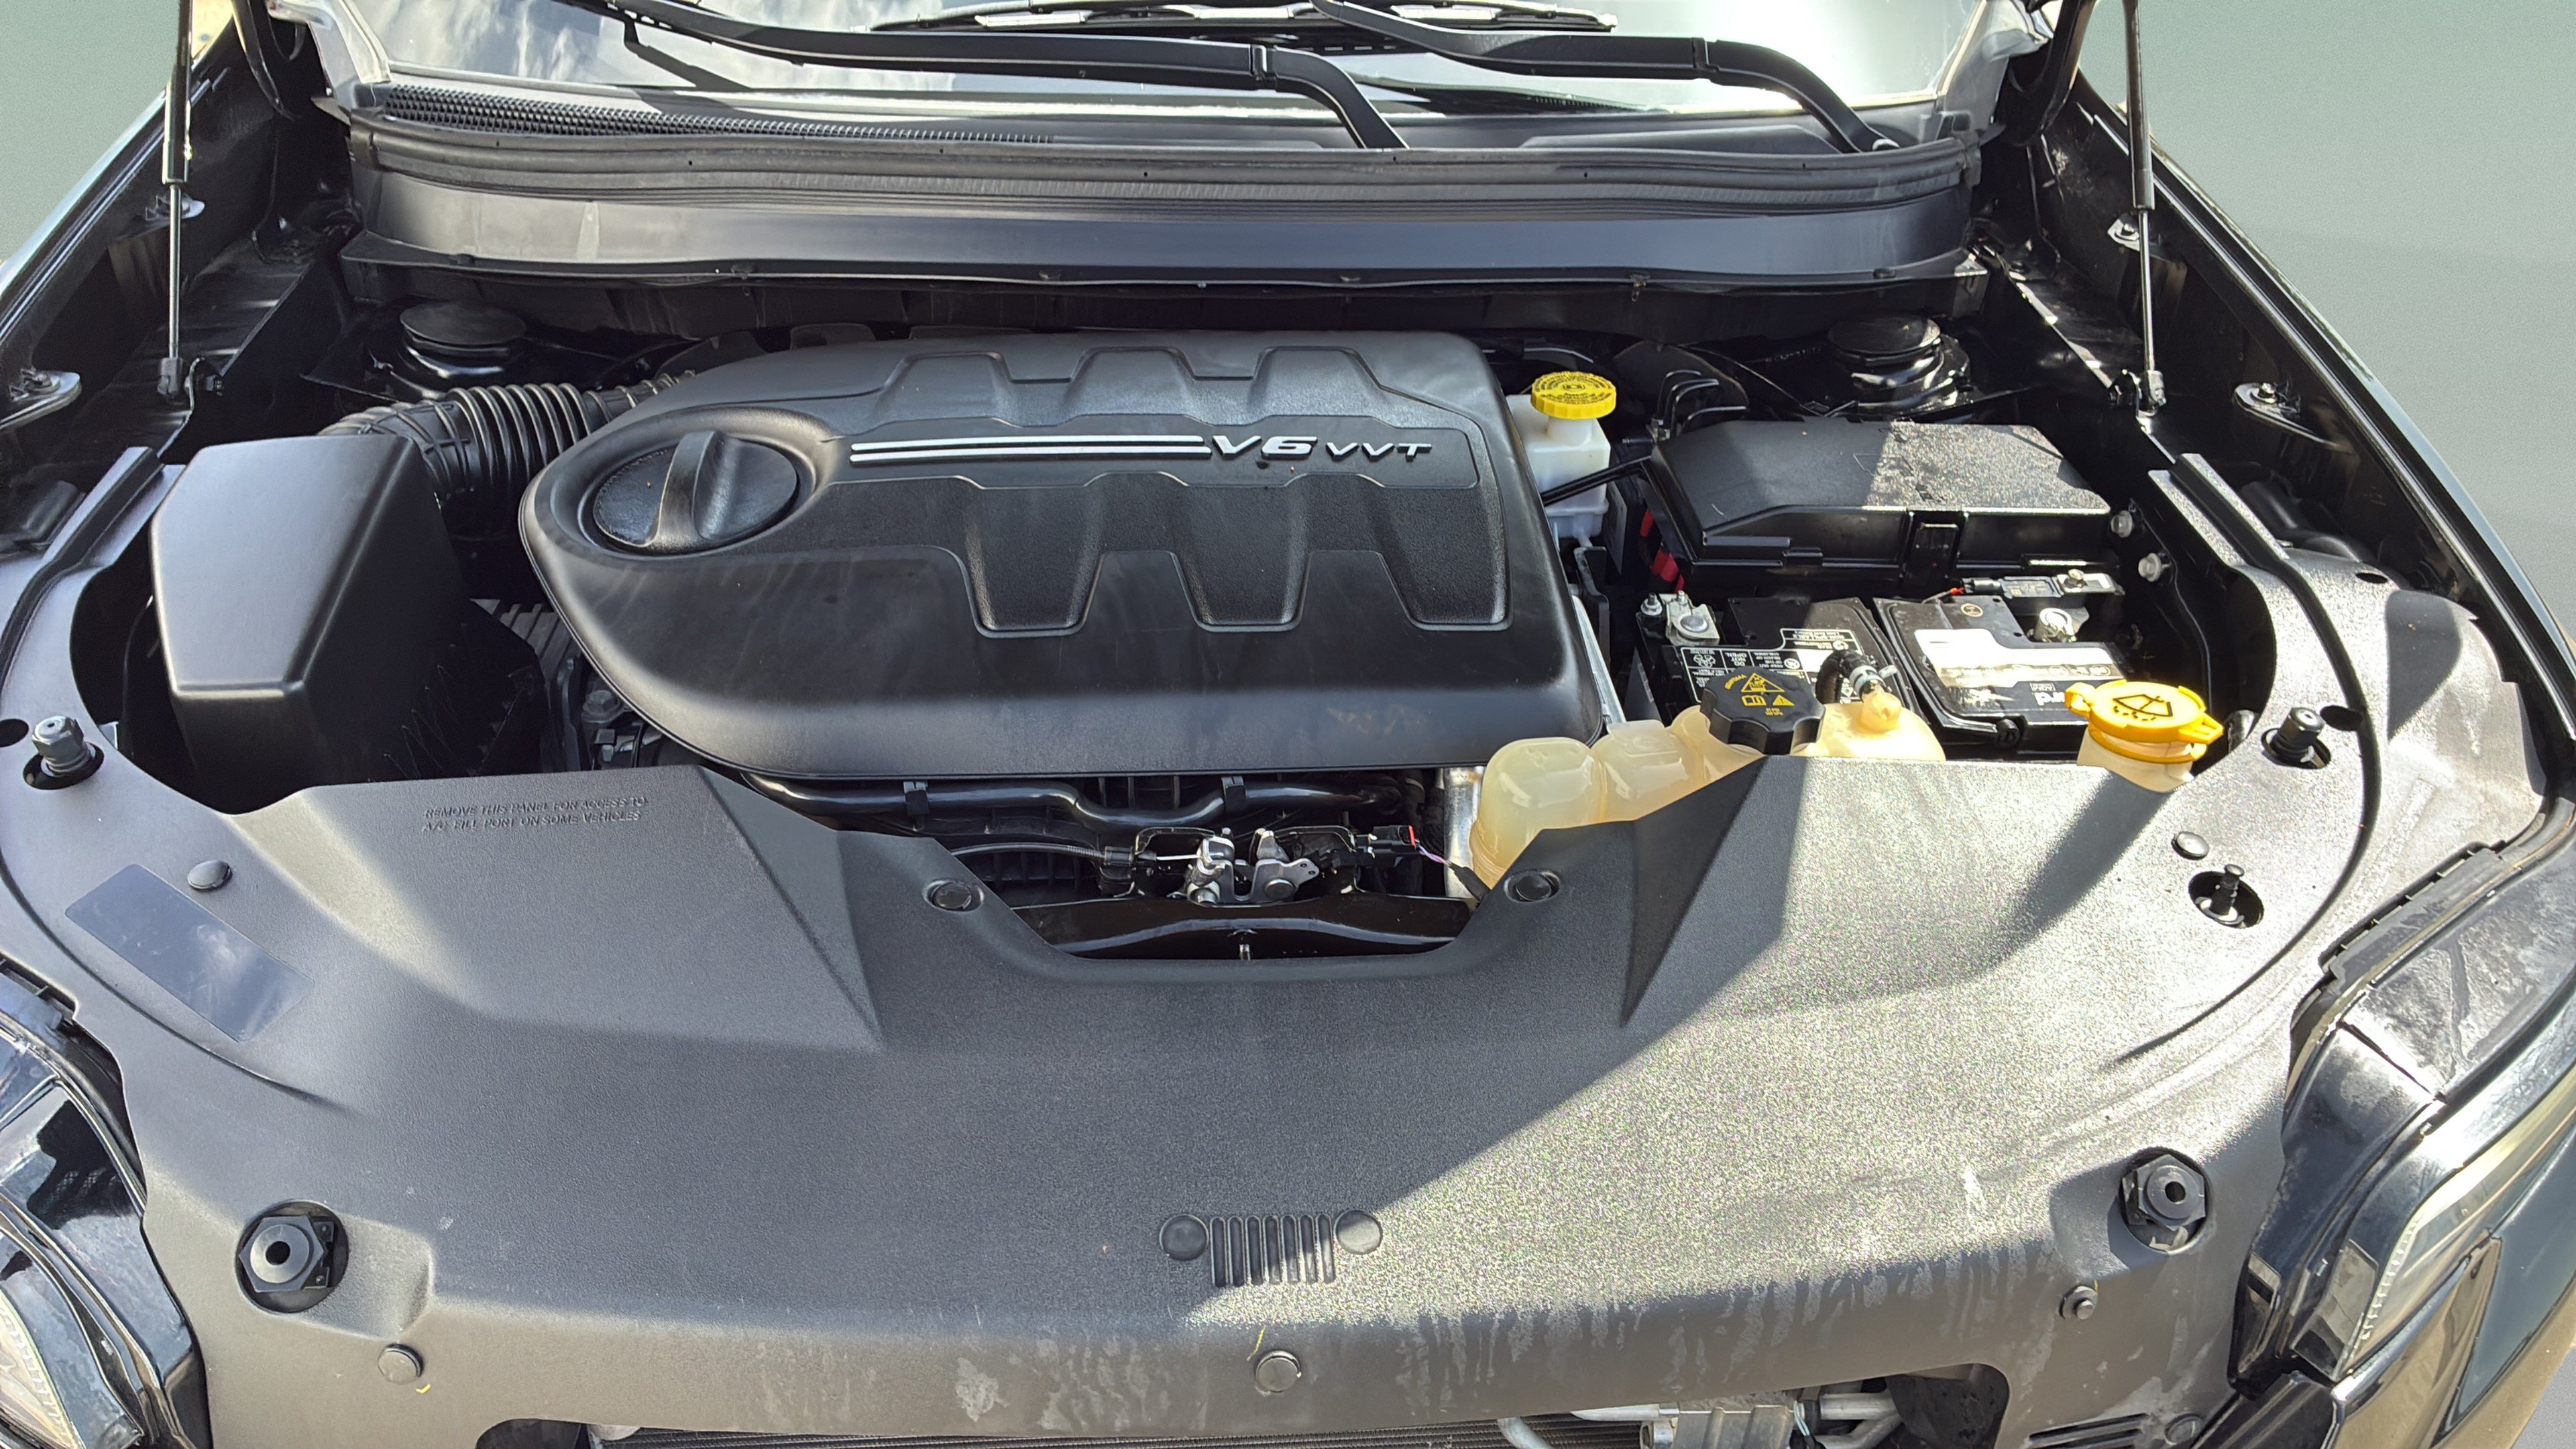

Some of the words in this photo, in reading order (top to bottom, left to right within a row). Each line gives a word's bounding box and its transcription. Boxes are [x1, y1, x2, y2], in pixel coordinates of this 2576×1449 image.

[1212, 435, 1318, 460] V6
[1326, 442, 1432, 462] VVT
[425, 806, 476, 818] REMOVE
[480, 804, 508, 816] THIS
[510, 802, 549, 814] PANEL
[553, 800, 577, 811] FOR
[579, 798, 628, 810] ACCESS
[630, 796, 647, 807] TO
[451, 820, 478, 830] FILL
[483, 818, 516, 828] PORT
[519, 816, 539, 826] ON
[541, 814, 579, 825] SOME
[582, 810, 641, 824] VEHICLES
